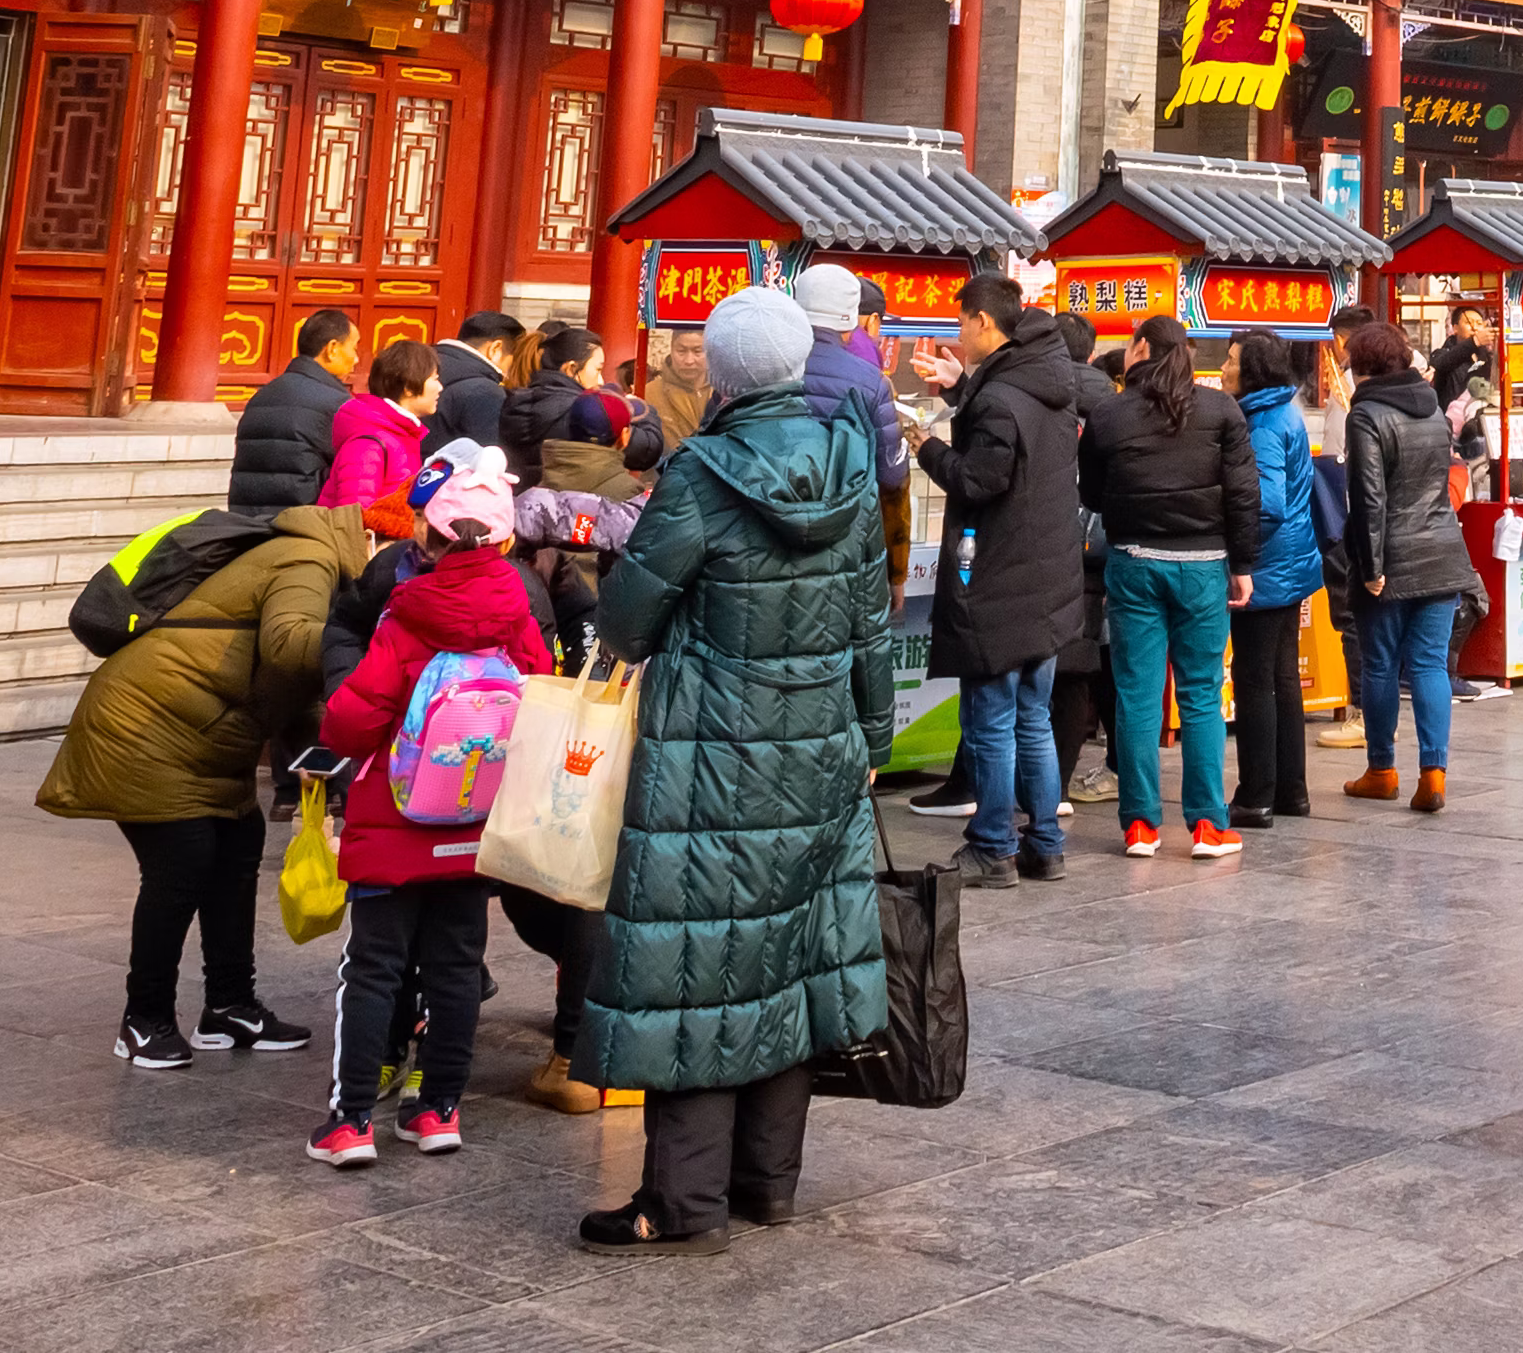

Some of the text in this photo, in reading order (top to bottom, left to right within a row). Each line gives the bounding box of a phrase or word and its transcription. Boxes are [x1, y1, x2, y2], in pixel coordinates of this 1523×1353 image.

[855, 270, 967, 308] 記茶湯
[1068, 278, 1149, 313] 熟梨糕
[906, 562, 938, 580] 物质
